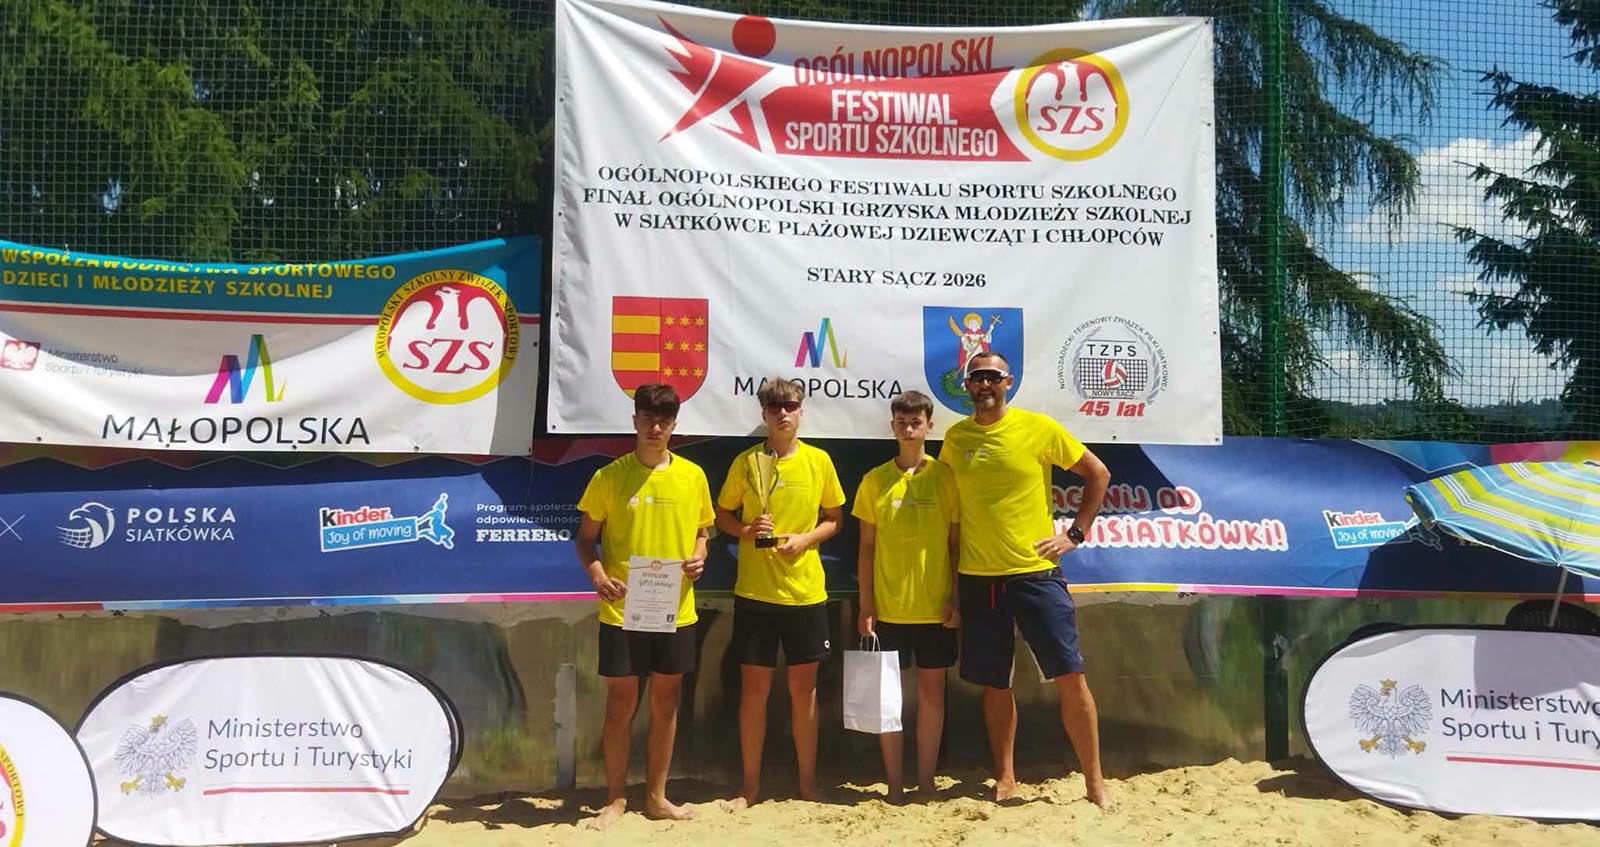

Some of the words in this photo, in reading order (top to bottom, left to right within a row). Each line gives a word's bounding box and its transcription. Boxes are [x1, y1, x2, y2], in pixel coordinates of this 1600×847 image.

[794, 36, 994, 85] OGÓLNOPOLSKI
[831, 89, 958, 126] FESTIWAL
[1037, 105, 1105, 134] SZS
[785, 122, 869, 152] SPORTU
[876, 125, 998, 157] SZKOLNEGO
[598, 164, 822, 193] OGÓLNOPOLSKIEGO
[829, 180, 951, 198] FESTIWALU
[958, 184, 1044, 199] SPORTU
[1051, 184, 1177, 202] SZKOLNEGO
[583, 188, 652, 206] FINAŁ
[658, 189, 835, 216] OGÓLNOPOLSKI
[842, 201, 949, 220] IGRZYSKA
[955, 203, 1079, 222] MŁODZIEŻY
[1086, 206, 1192, 225] SZKOLNEJ
[615, 213, 633, 229] W
[639, 212, 771, 234] SIATKÓWCE
[778, 219, 894, 241] PLAŻOWEJ
[900, 227, 1025, 247] DZIEWCZĄT
[1032, 229, 1039, 244] I
[1046, 227, 1164, 247] CHŁOPCÓW
[2, 270, 68, 288] DZIECI
[77, 274, 83, 289] I
[93, 274, 215, 295] MŁODZIEŻY
[226, 281, 333, 298] SZKOLNEJ
[404, 270, 454, 293] SZKOLNY
[807, 266, 876, 284] STARY
[882, 270, 937, 288] SĄCZ
[943, 272, 986, 288] 2026
[1073, 316, 1112, 335] TERENOWY
[403, 338, 494, 374] SZS
[1087, 344, 1137, 357] TZPS
[734, 376, 902, 400] MAOPOLSKA
[1078, 400, 1110, 416] 45
[1116, 401, 1145, 416] lat
[102, 414, 370, 445] MAŁOPOLSKA
[476, 503, 527, 513] Program
[530, 503, 577, 513] społecz
[1158, 488, 1196, 510] OD
[127, 507, 236, 524] POLSKA
[476, 514, 581, 525] odpowiedzialnośc
[126, 525, 235, 542] SIATKÓWKA
[328, 530, 350, 545] Joy
[352, 528, 366, 541] of
[368, 524, 412, 539] moving
[476, 529, 571, 542] FERRERO
[1338, 530, 1357, 544] Joy
[1358, 529, 1369, 540] of
[208, 718, 363, 739] Ministerstwo
[1443, 717, 1526, 741] Sportu
[1535, 720, 1541, 741] i
[204, 749, 284, 772] Sportu
[294, 747, 300, 766] i
[309, 746, 413, 773] Turystyki
